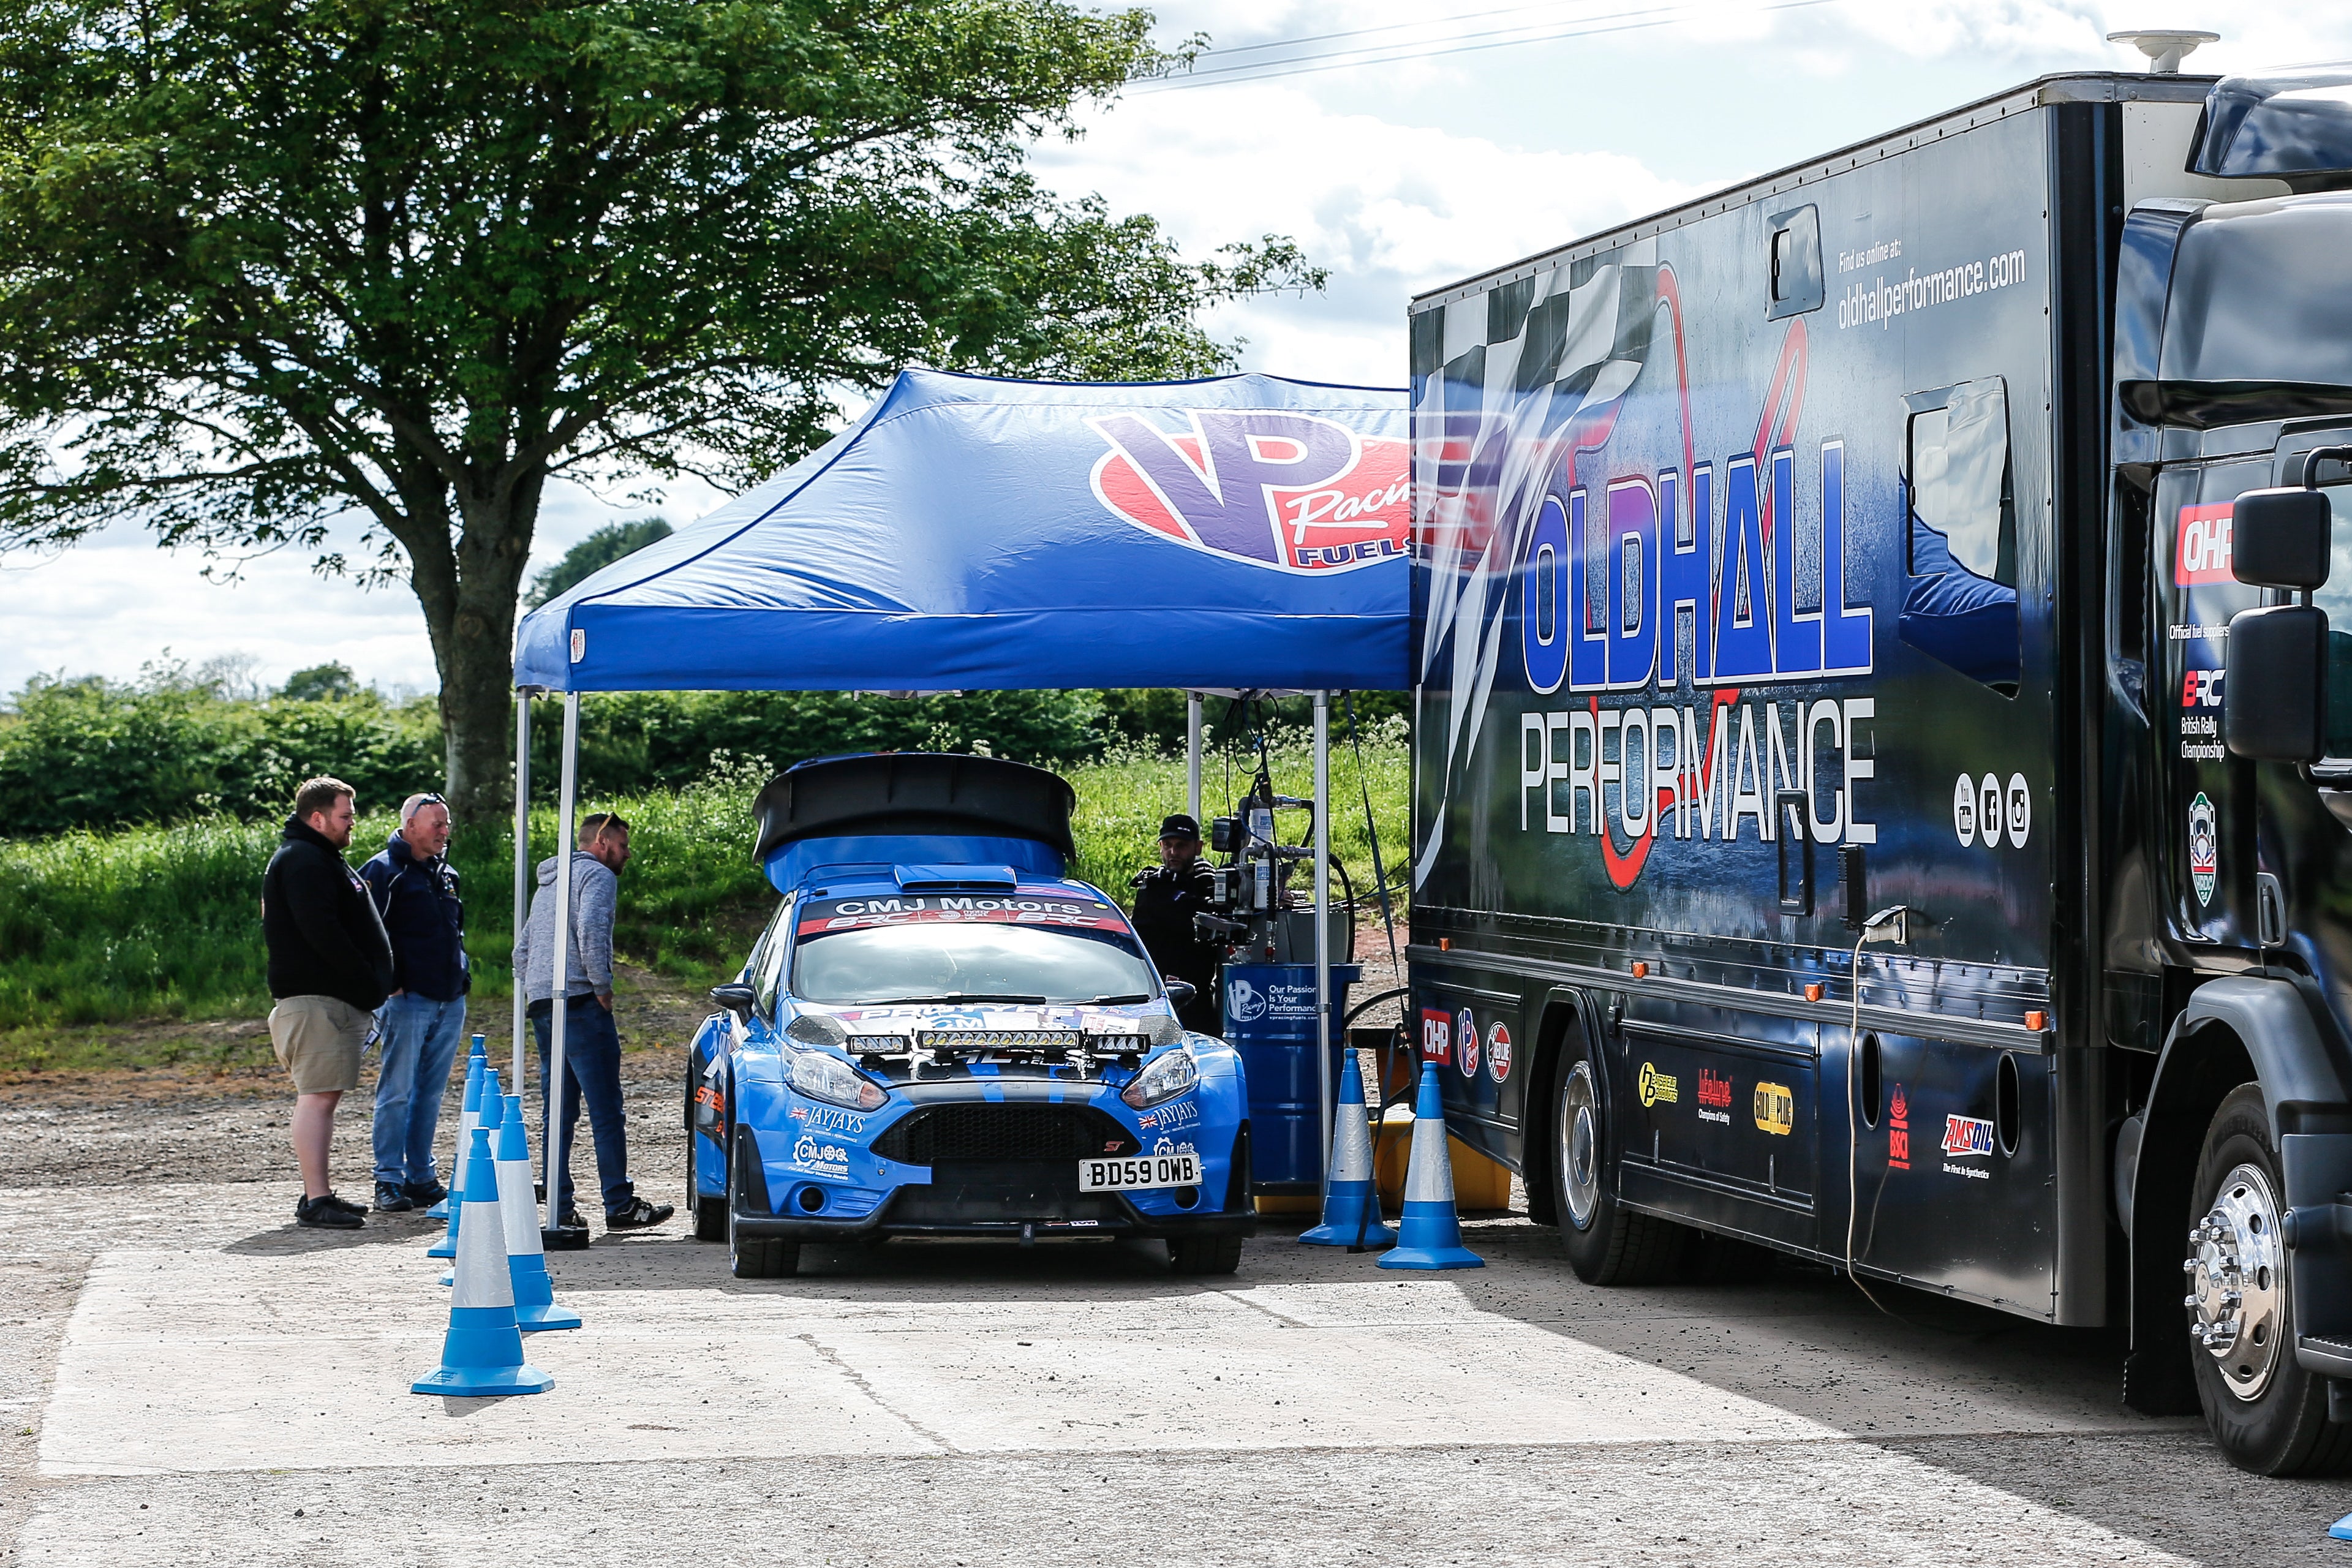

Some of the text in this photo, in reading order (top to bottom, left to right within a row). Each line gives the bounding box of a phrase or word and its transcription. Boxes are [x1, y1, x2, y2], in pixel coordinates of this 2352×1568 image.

[1839, 238, 1901, 274] Find us online at:
[1839, 249, 2026, 330] oldhallperformance.com
[1082, 408, 1362, 568] VP
[1286, 472, 1410, 545] Raci
[1521, 436, 1874, 695] OLDHALL
[2169, 622, 2230, 641] Official fuel suppliers
[2182, 669, 2226, 707] BRC
[2181, 715, 2217, 737] British Rally
[2181, 741, 2225, 762] Championship
[1521, 697, 1877, 844] PERFORMANCE
[835, 898, 926, 915] CMJ
[940, 897, 1082, 915] Motors
[1016, 911, 1101, 926] BRC
[826, 911, 913, 929] BRC
[1227, 980, 1252, 1020] VP
[1269, 985, 1285, 993] Our
[1242, 1001, 1265, 1014] Racing
[1424, 1019, 1449, 1055] OHP
[804, 1106, 865, 1133] JAYJAYS
[1154, 1101, 1197, 1131] JAYJAYS
[1698, 1108, 1730, 1126] Champions of Safety
[1755, 1090, 1792, 1126] GOLD PLUG
[1104, 1141, 1124, 1152] ST
[1890, 1129, 1909, 1159] BSCI
[1943, 1117, 1992, 1153] AMSOIL
[799, 1144, 824, 1159] CMJ
[1091, 1158, 1194, 1186] BD59 OWB
[1951, 1165, 1961, 1175] First
[1966, 1167, 1989, 1179] Synthetics
[634, 1208, 650, 1221] N
